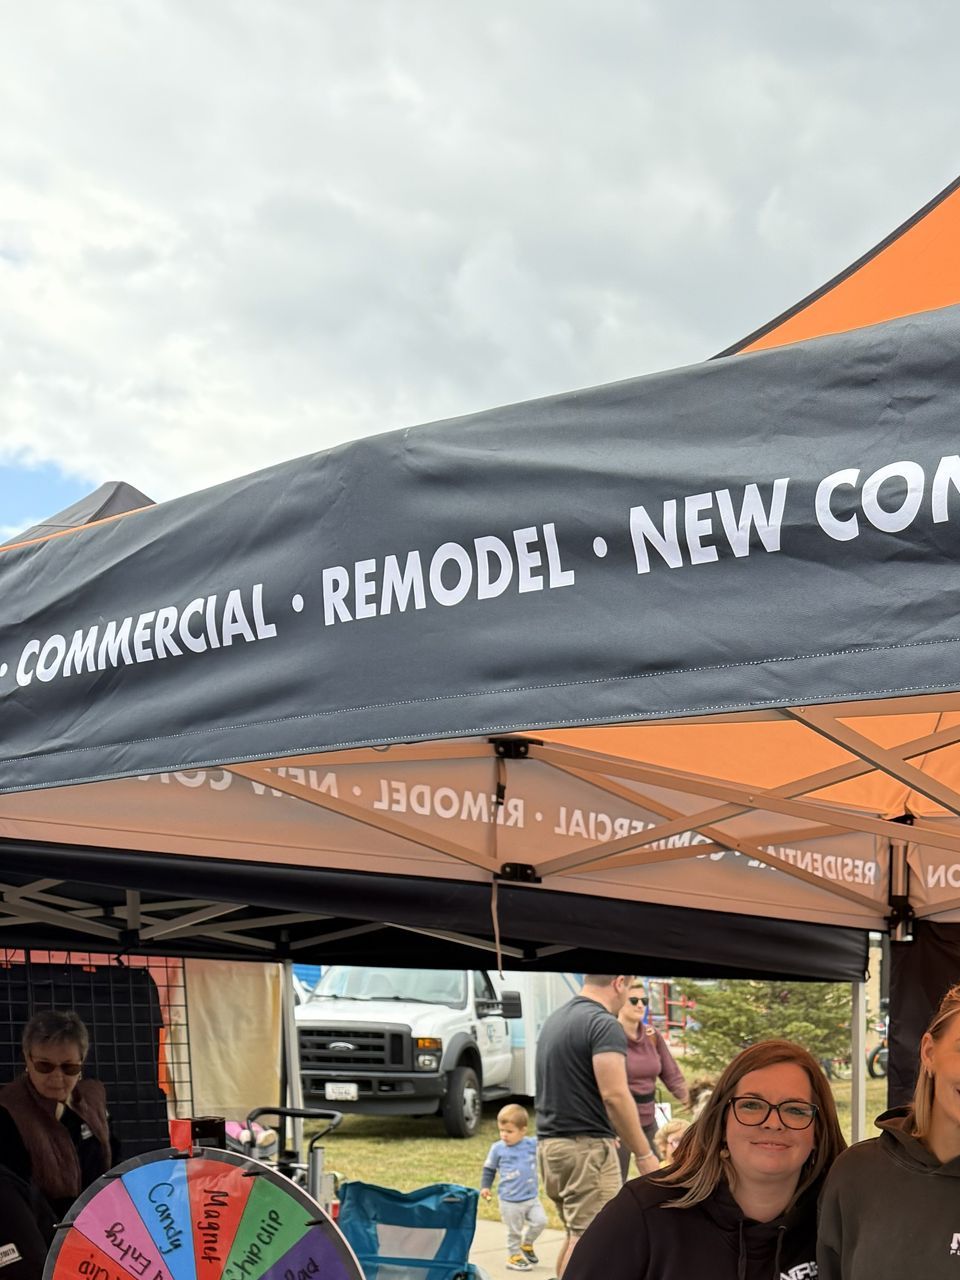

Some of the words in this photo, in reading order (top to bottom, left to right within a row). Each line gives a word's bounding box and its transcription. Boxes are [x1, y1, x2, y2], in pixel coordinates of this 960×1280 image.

[16, 583, 277, 687] COMMERCIAL
[321, 523, 575, 626] REMODEL
[629, 477, 790, 575] NEW
[104, 1222, 152, 1276] Entry
[148, 1182, 184, 1255] Candy
[197, 1189, 229, 1264] Magnet
